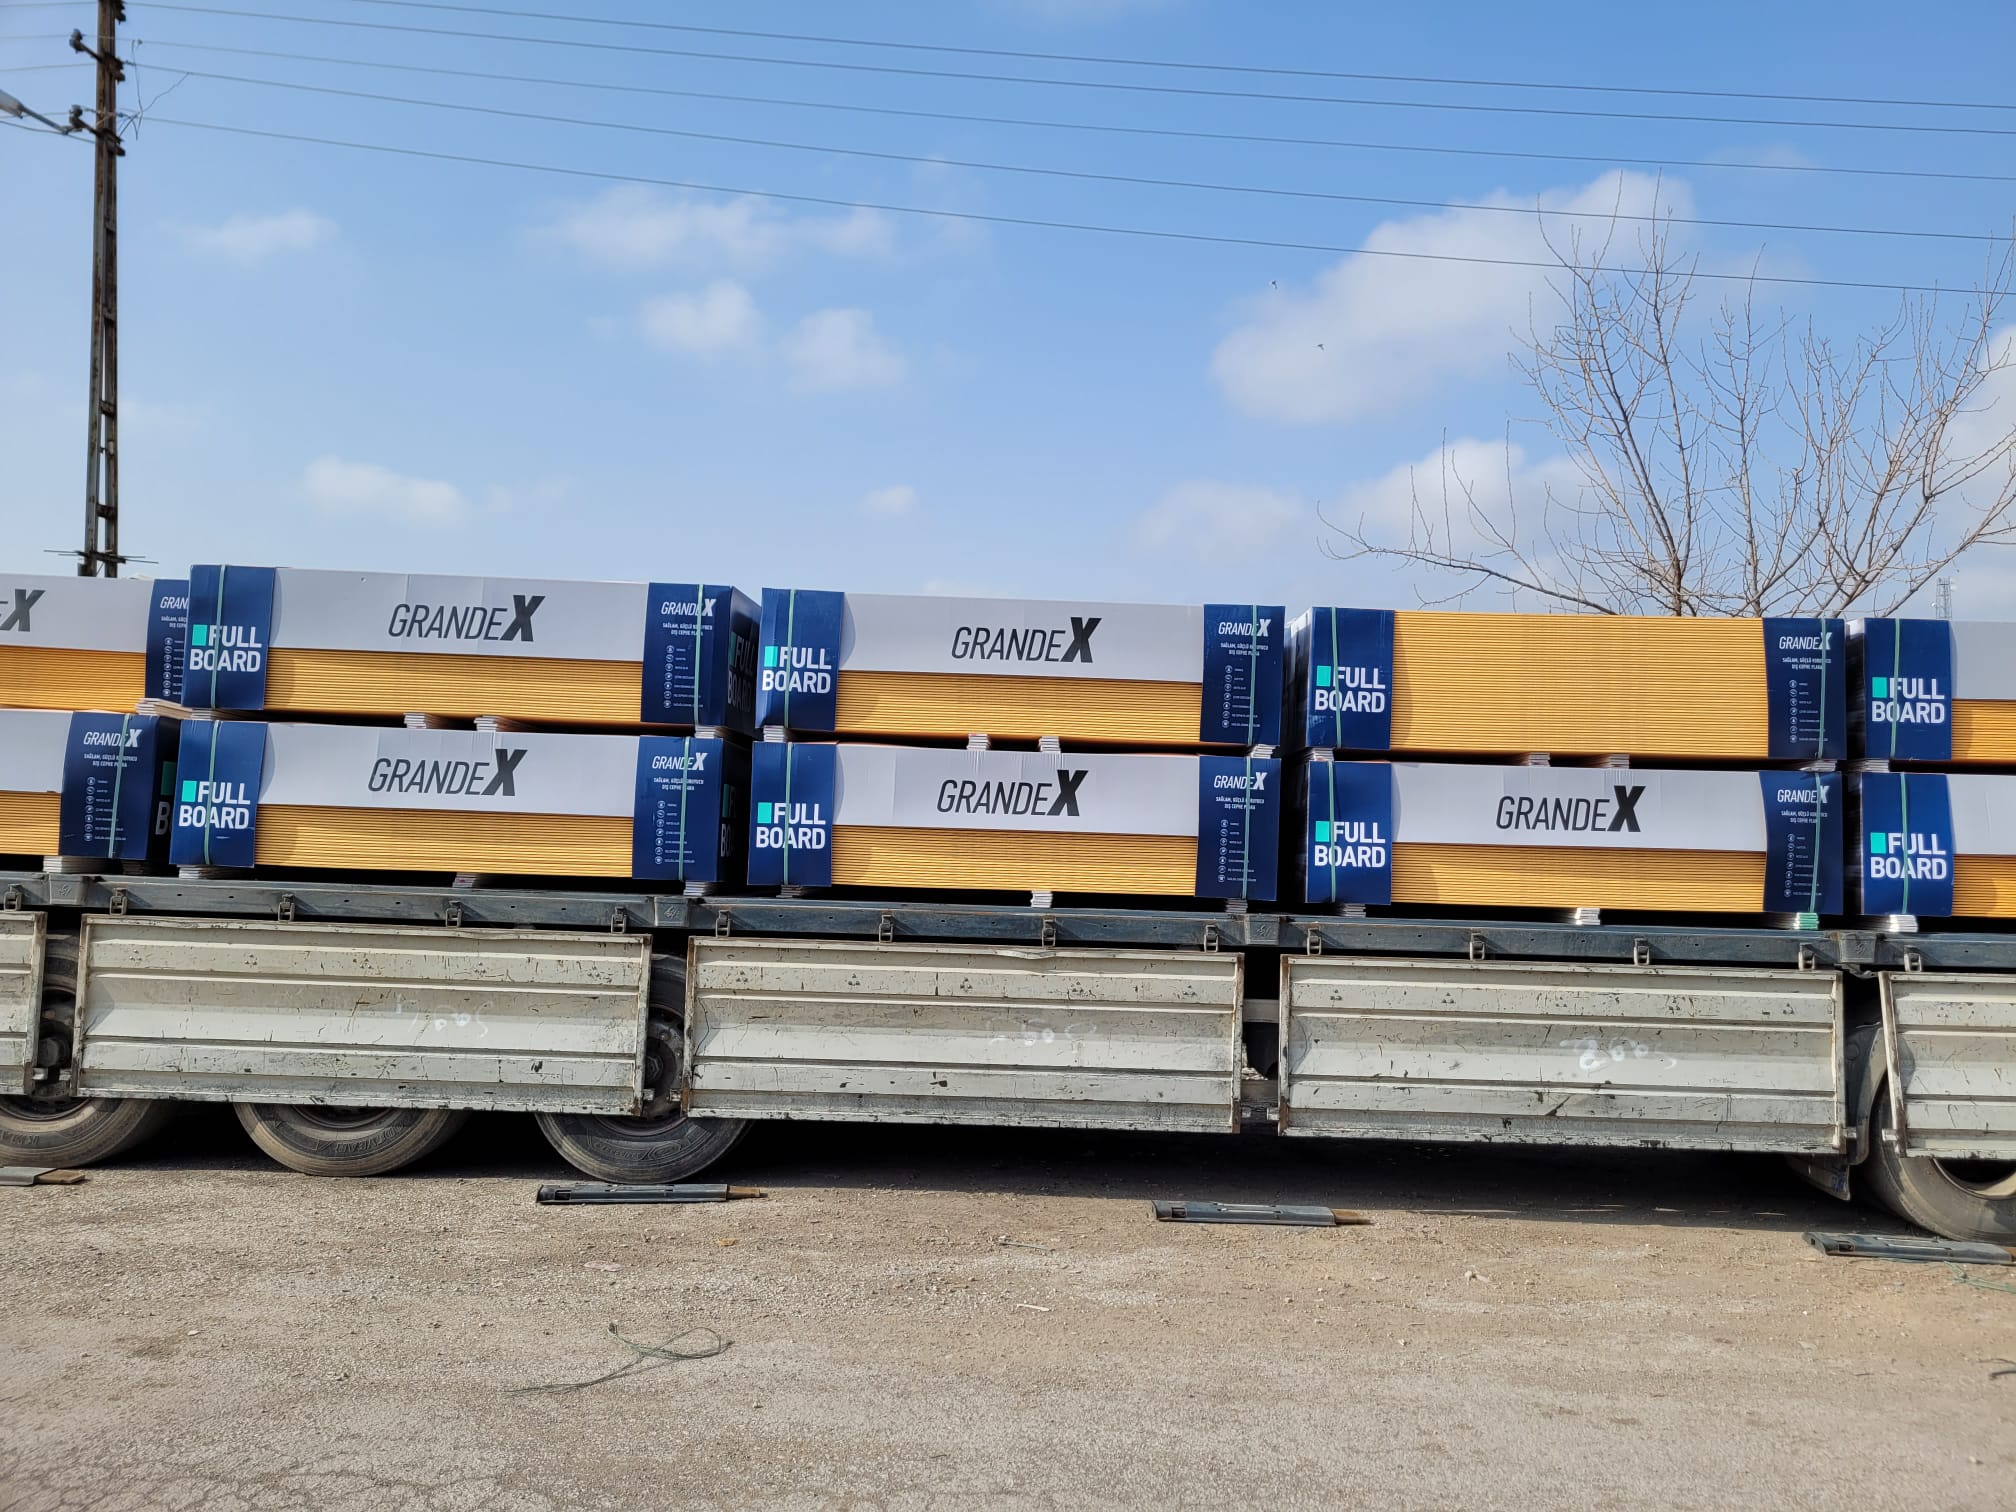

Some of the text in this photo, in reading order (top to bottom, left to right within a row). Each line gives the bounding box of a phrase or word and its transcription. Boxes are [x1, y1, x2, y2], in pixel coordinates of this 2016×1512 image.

[0, 589, 46, 632] X
[388, 595, 545, 642] GRANDEX
[661, 599, 716, 616] GRANDX
[208, 625, 262, 648] FULL
[1218, 618, 1271, 637] GRANDX
[951, 617, 1102, 663] GRANDEX
[1779, 632, 1832, 650] GRANDEX
[190, 649, 261, 672] BOARD
[779, 646, 831, 670] FULL
[762, 670, 831, 694] BOARD
[1332, 666, 1386, 689] FULL
[1889, 677, 1945, 700] FULL
[1314, 689, 1385, 713] BOARD
[1871, 701, 1945, 724] BOARD
[368, 749, 527, 796] GRANDEX
[198, 781, 252, 805] FULL
[937, 769, 1089, 817] GRANDEX
[1777, 785, 1829, 803] GRANDEX
[179, 806, 249, 829] BOARD
[773, 802, 826, 825] FULL
[1496, 785, 1646, 832] GRANDEX
[756, 826, 826, 849] BOARD
[1332, 821, 1386, 844] FULL
[1888, 832, 1946, 855] FULL
[1314, 845, 1386, 868] BOARD
[1870, 857, 1947, 880] BOARD
